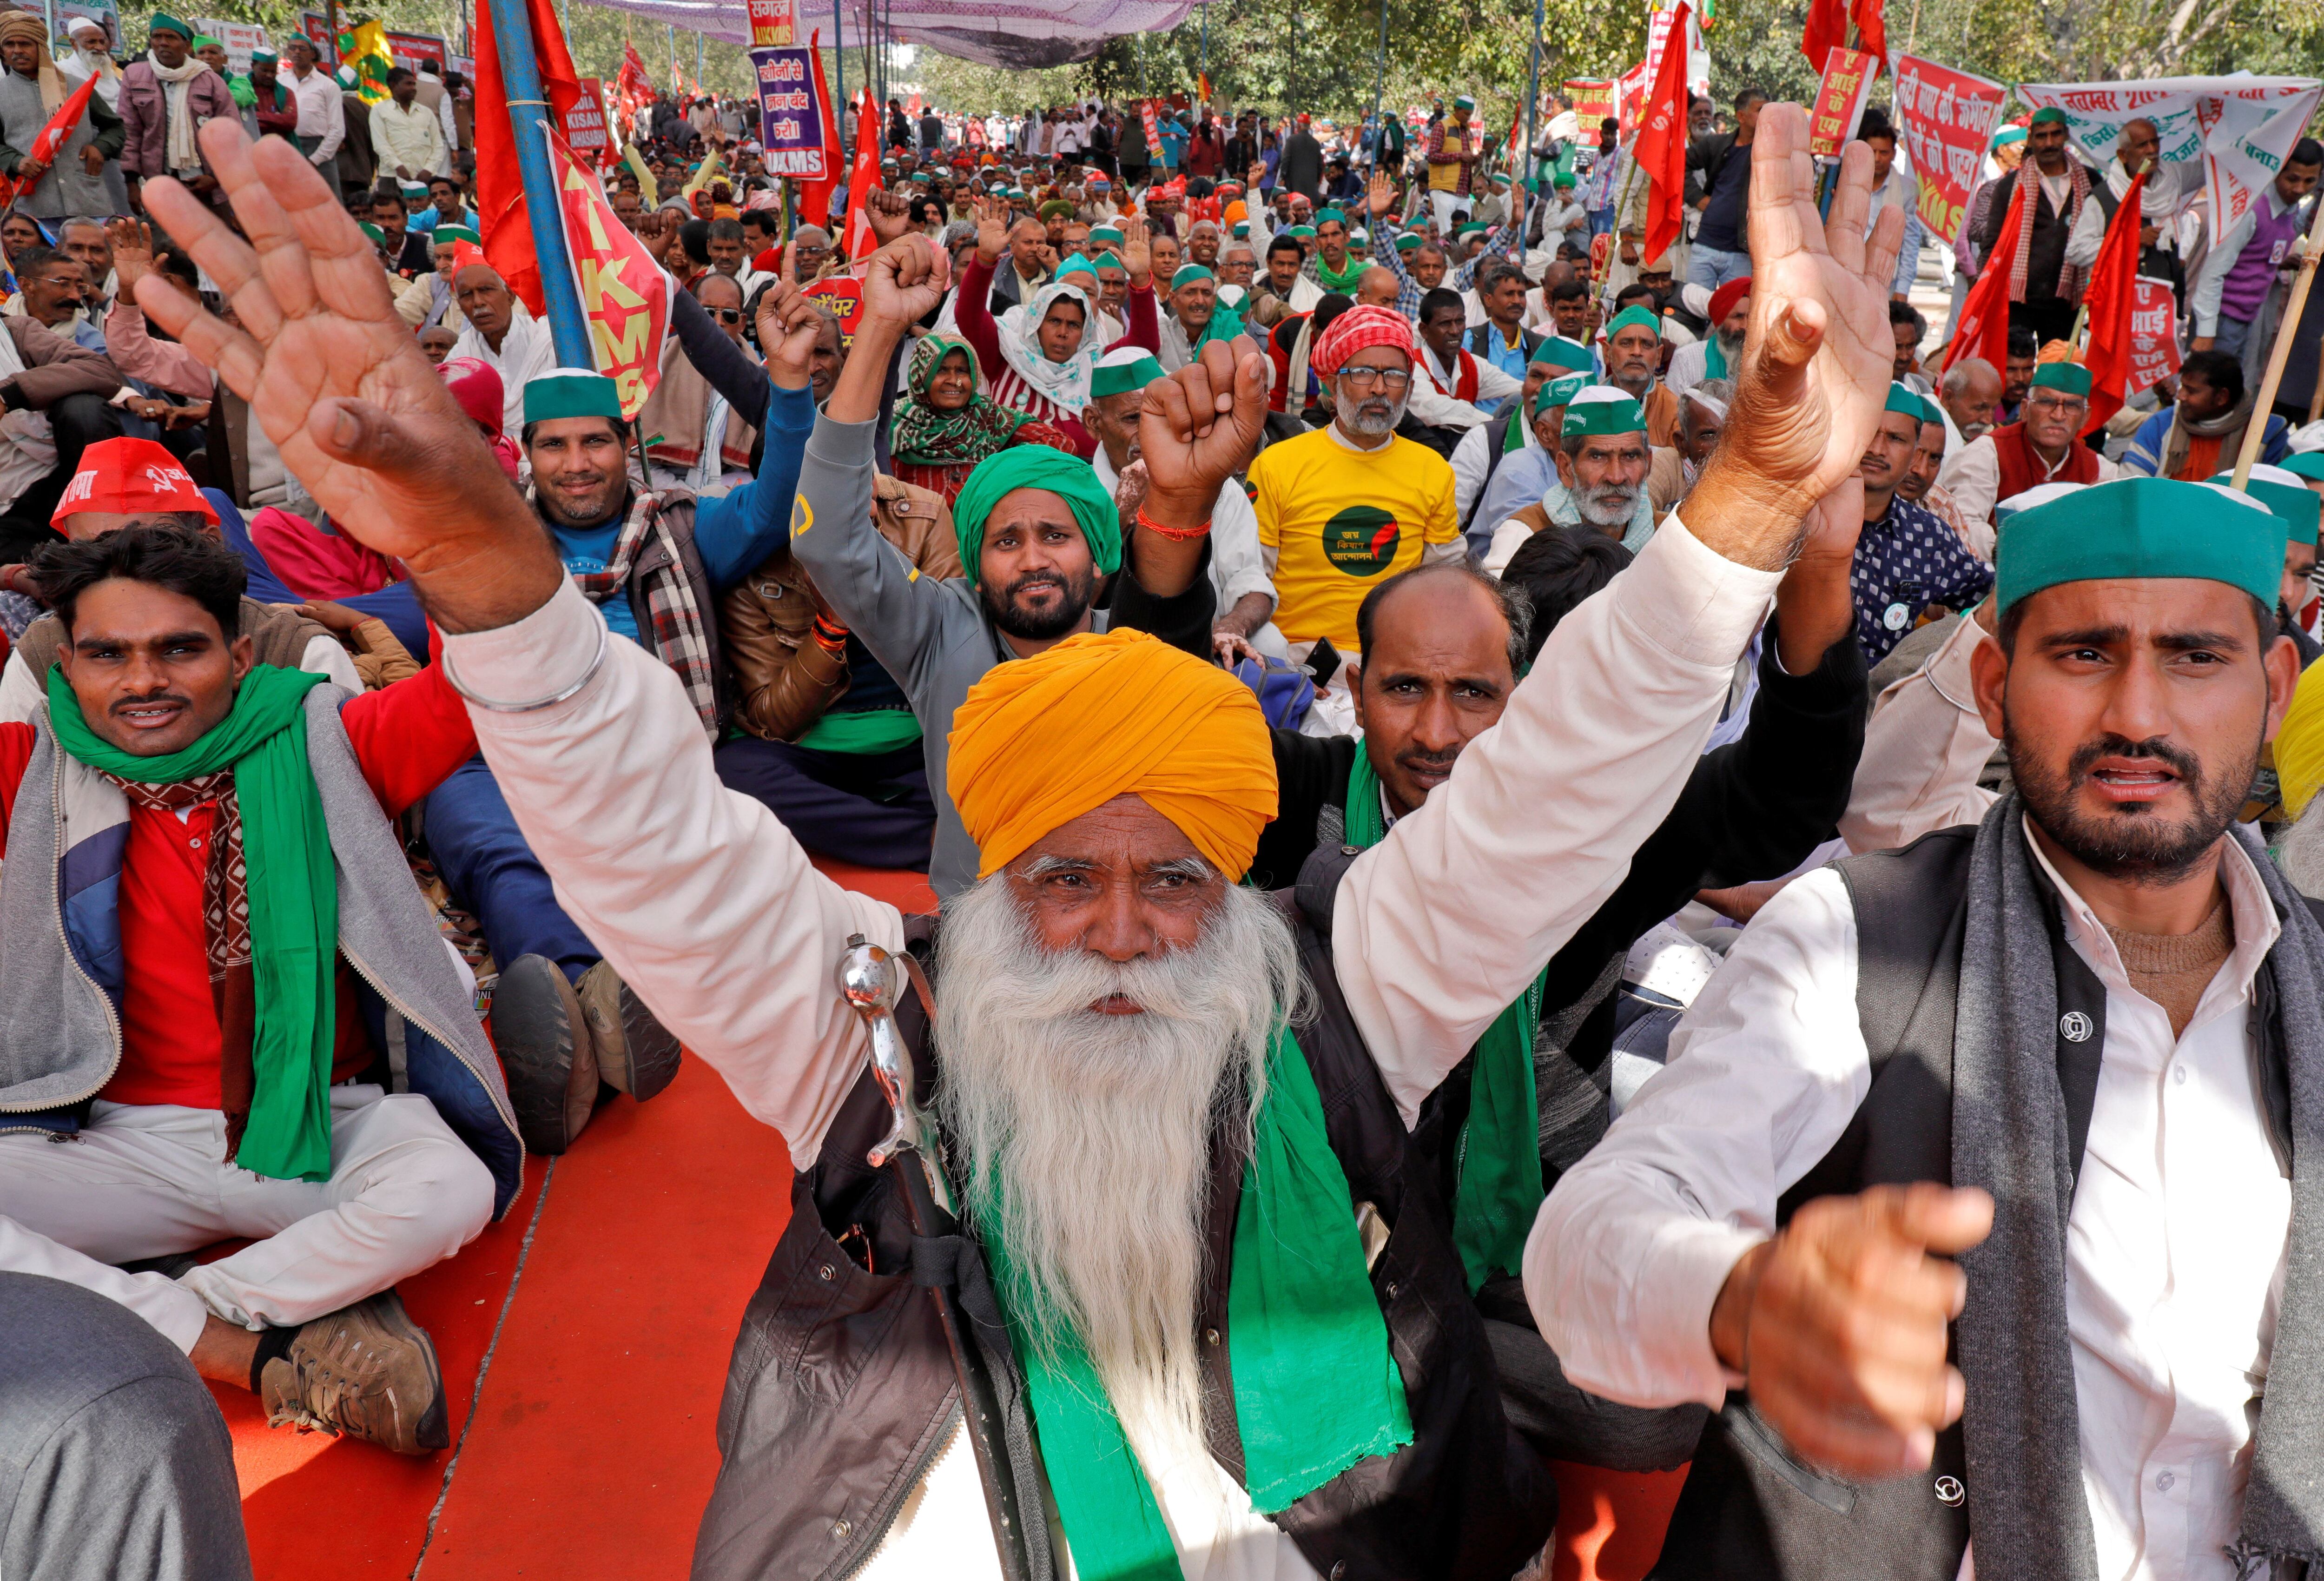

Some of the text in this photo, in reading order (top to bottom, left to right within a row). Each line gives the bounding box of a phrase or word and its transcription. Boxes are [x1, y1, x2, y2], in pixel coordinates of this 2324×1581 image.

[792, 60, 803, 80] से
[1843, 52, 1859, 69] ए
[790, 89, 808, 109] बंद
[1828, 91, 1846, 112] के
[566, 112, 603, 129] KISAN
[2135, 284, 2153, 304] ए
[832, 298, 856, 317] पर
[1331, 552, 1373, 561] আন্দোলন
